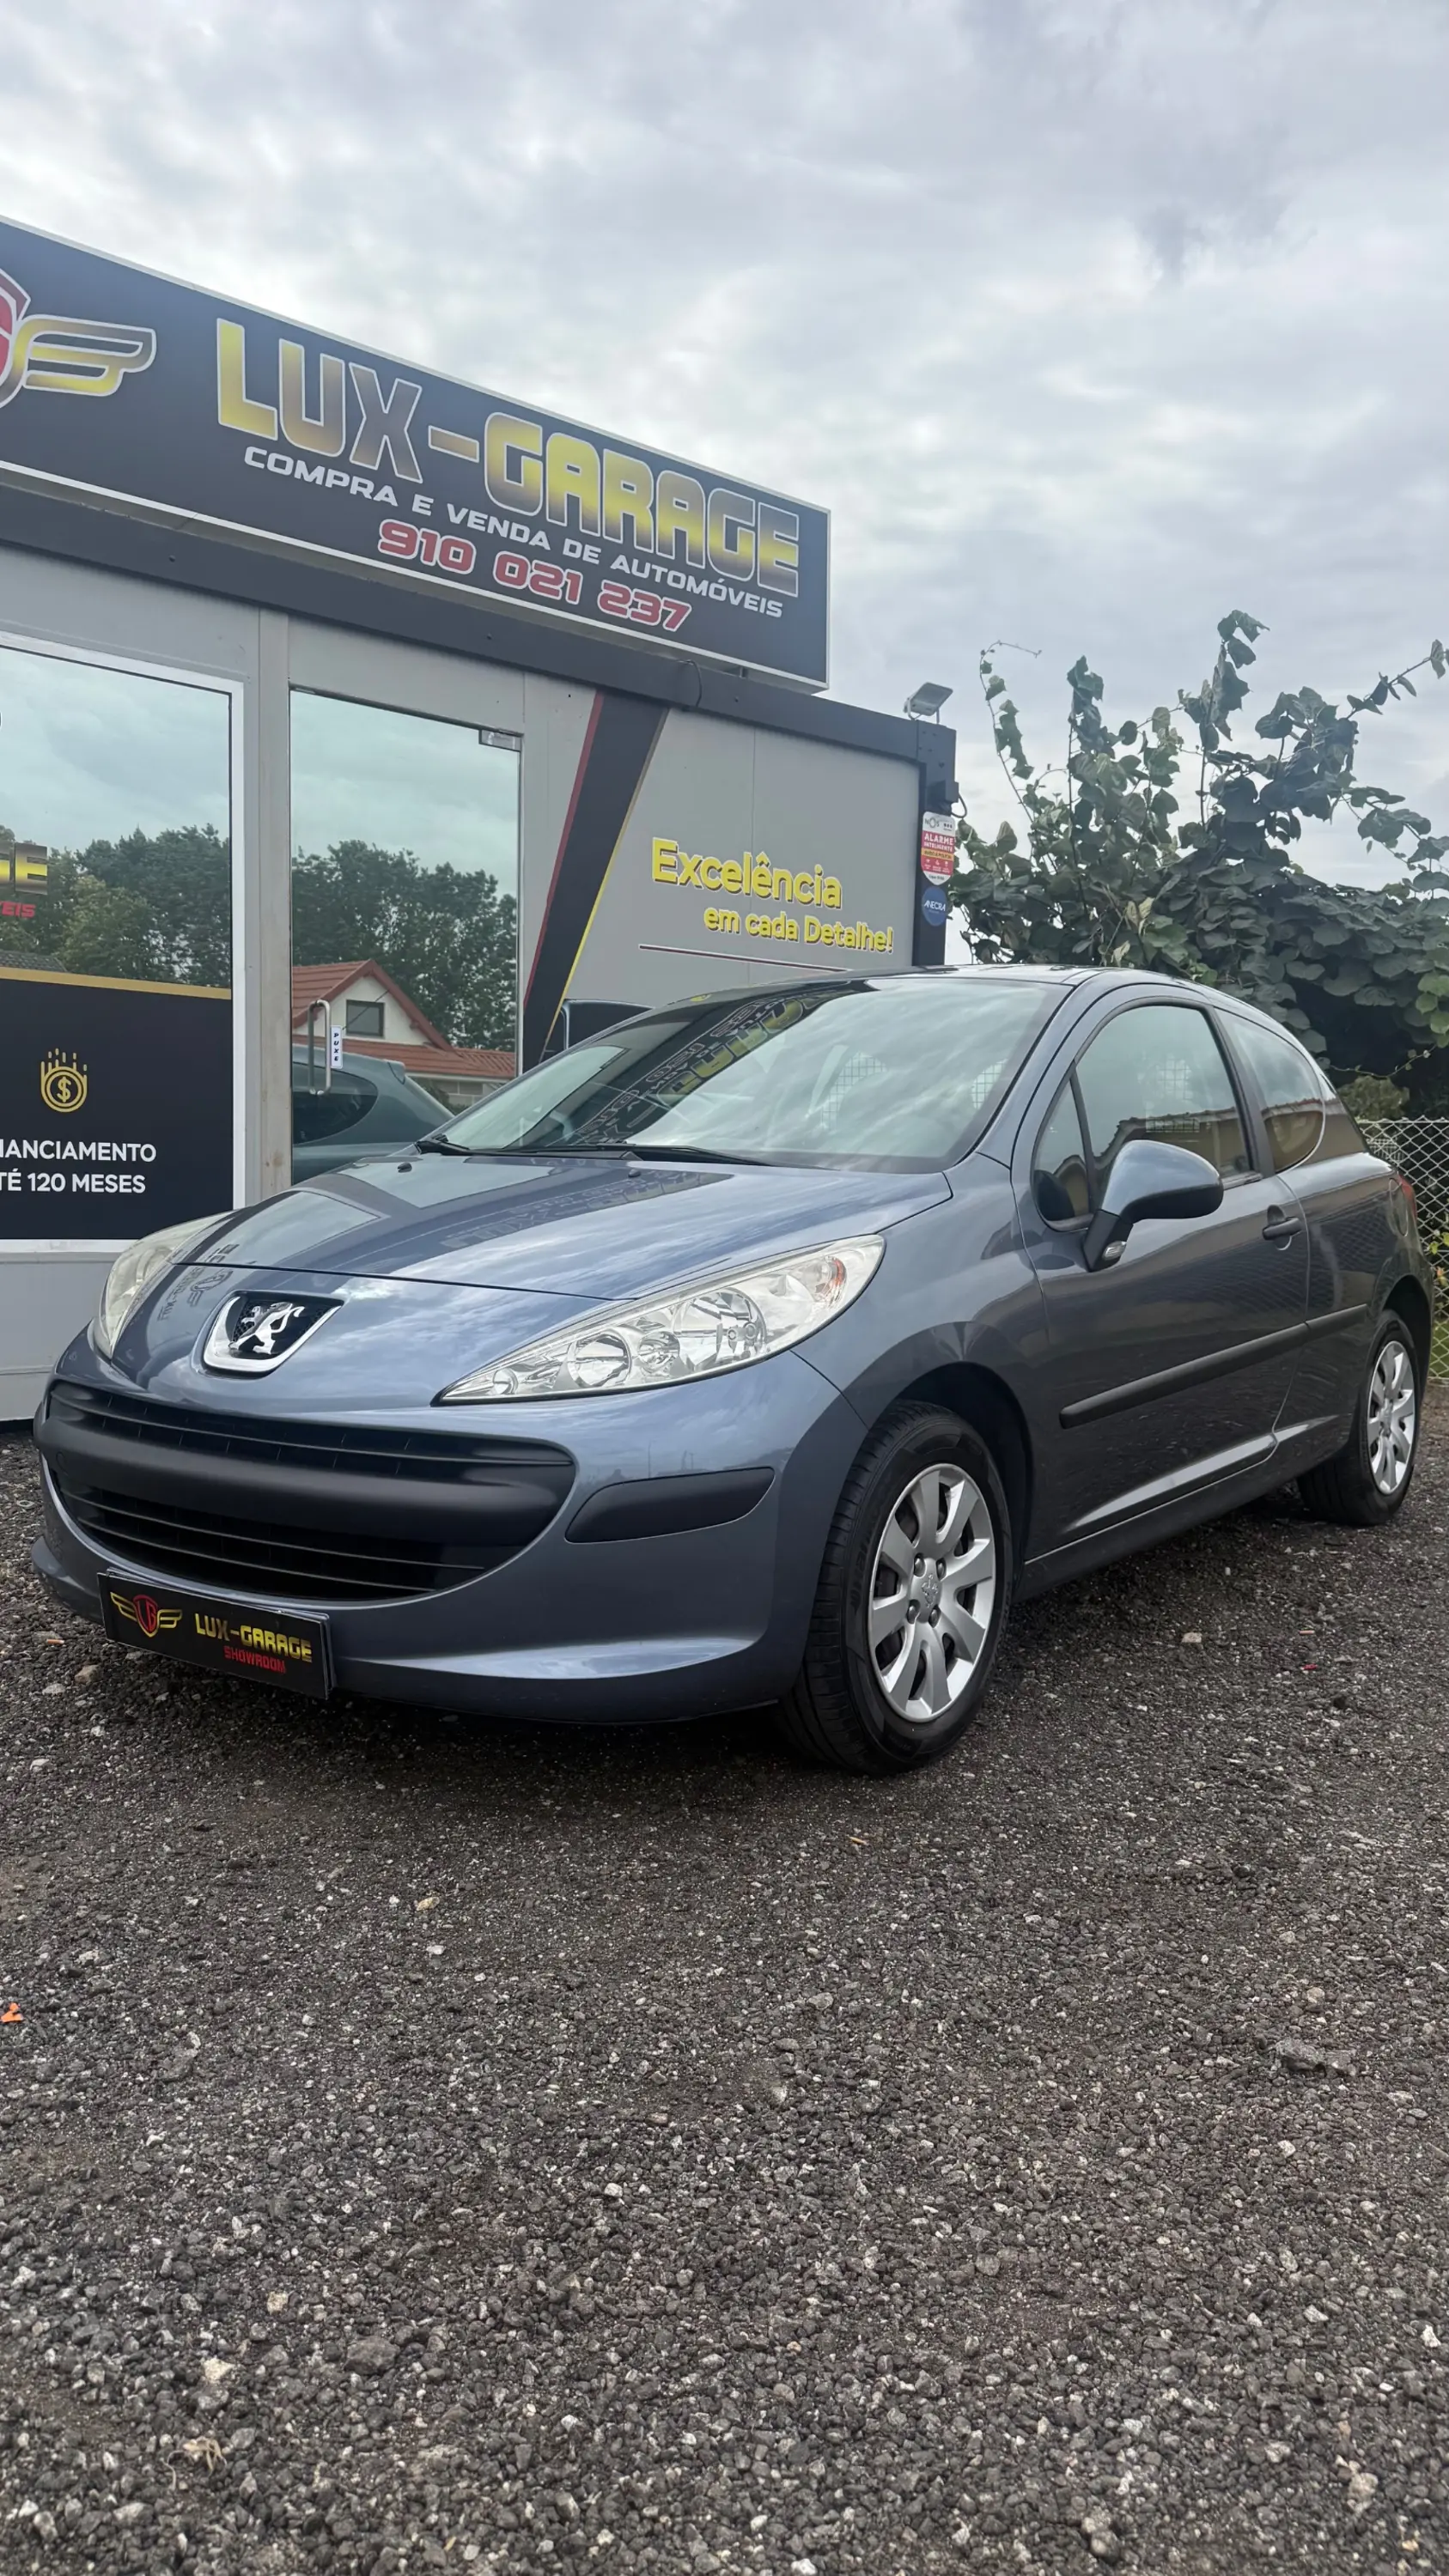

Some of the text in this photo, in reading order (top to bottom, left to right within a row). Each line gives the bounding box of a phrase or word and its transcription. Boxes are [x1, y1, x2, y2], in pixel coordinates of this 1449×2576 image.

[216, 318, 800, 597] LUX-GARAGE
[244, 446, 783, 618] COMPRA E VENDA DE AUTOMÓVEIS
[378, 519, 692, 631] 910 021 237
[924, 832, 954, 847] ALARME
[0, 841, 48, 896] E
[652, 837, 843, 909] Excelência
[0, 900, 36, 918] EIS
[924, 900, 947, 912] ANECRA
[703, 907, 894, 954] em cada Detalhe!
[0, 1139, 157, 1162] ANCIAMENTO
[27, 1172, 66, 1192] 120
[72, 1173, 146, 1194] MESES
[194, 1613, 313, 1663] LUX-GARAGE
[224, 1645, 286, 1674] SHOWROOM
